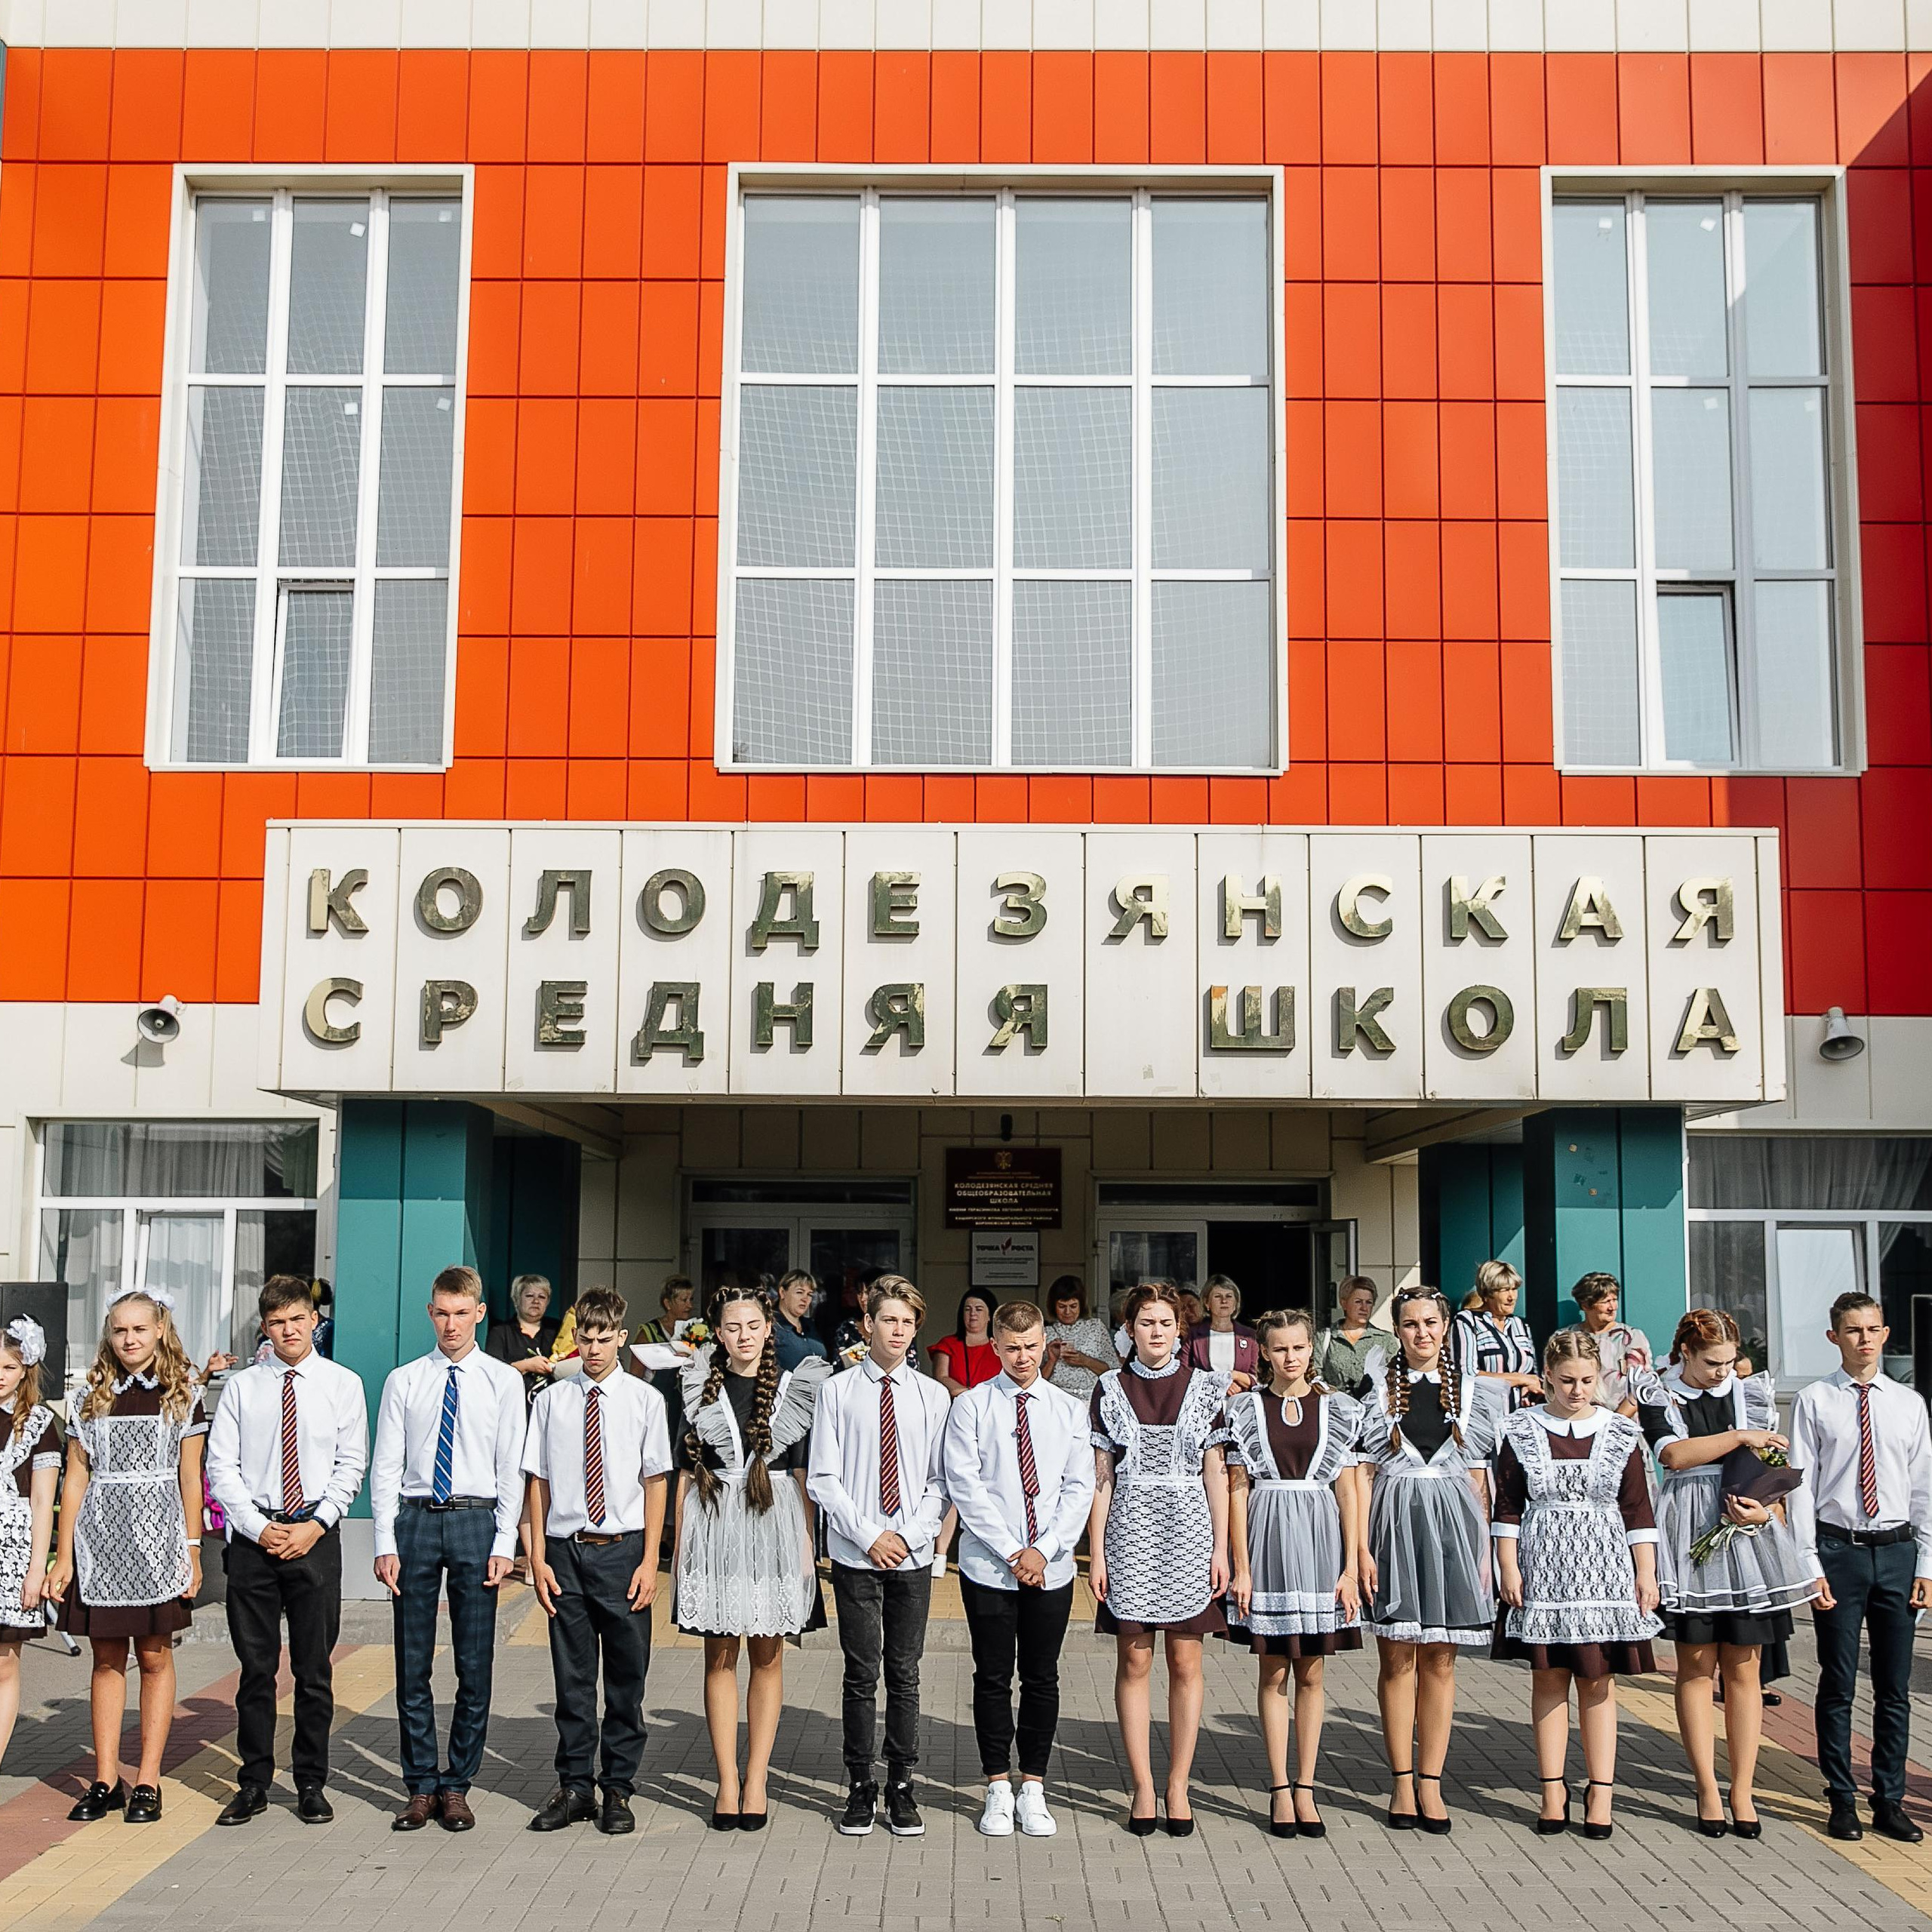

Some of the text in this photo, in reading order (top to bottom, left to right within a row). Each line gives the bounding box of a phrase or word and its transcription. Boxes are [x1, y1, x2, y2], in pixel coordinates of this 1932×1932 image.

[311, 867, 1734, 949] КОЛОДЕЗЯНСКАЯ
[306, 977, 1740, 1060] СРЕДНЯЯ ШКОЛА
